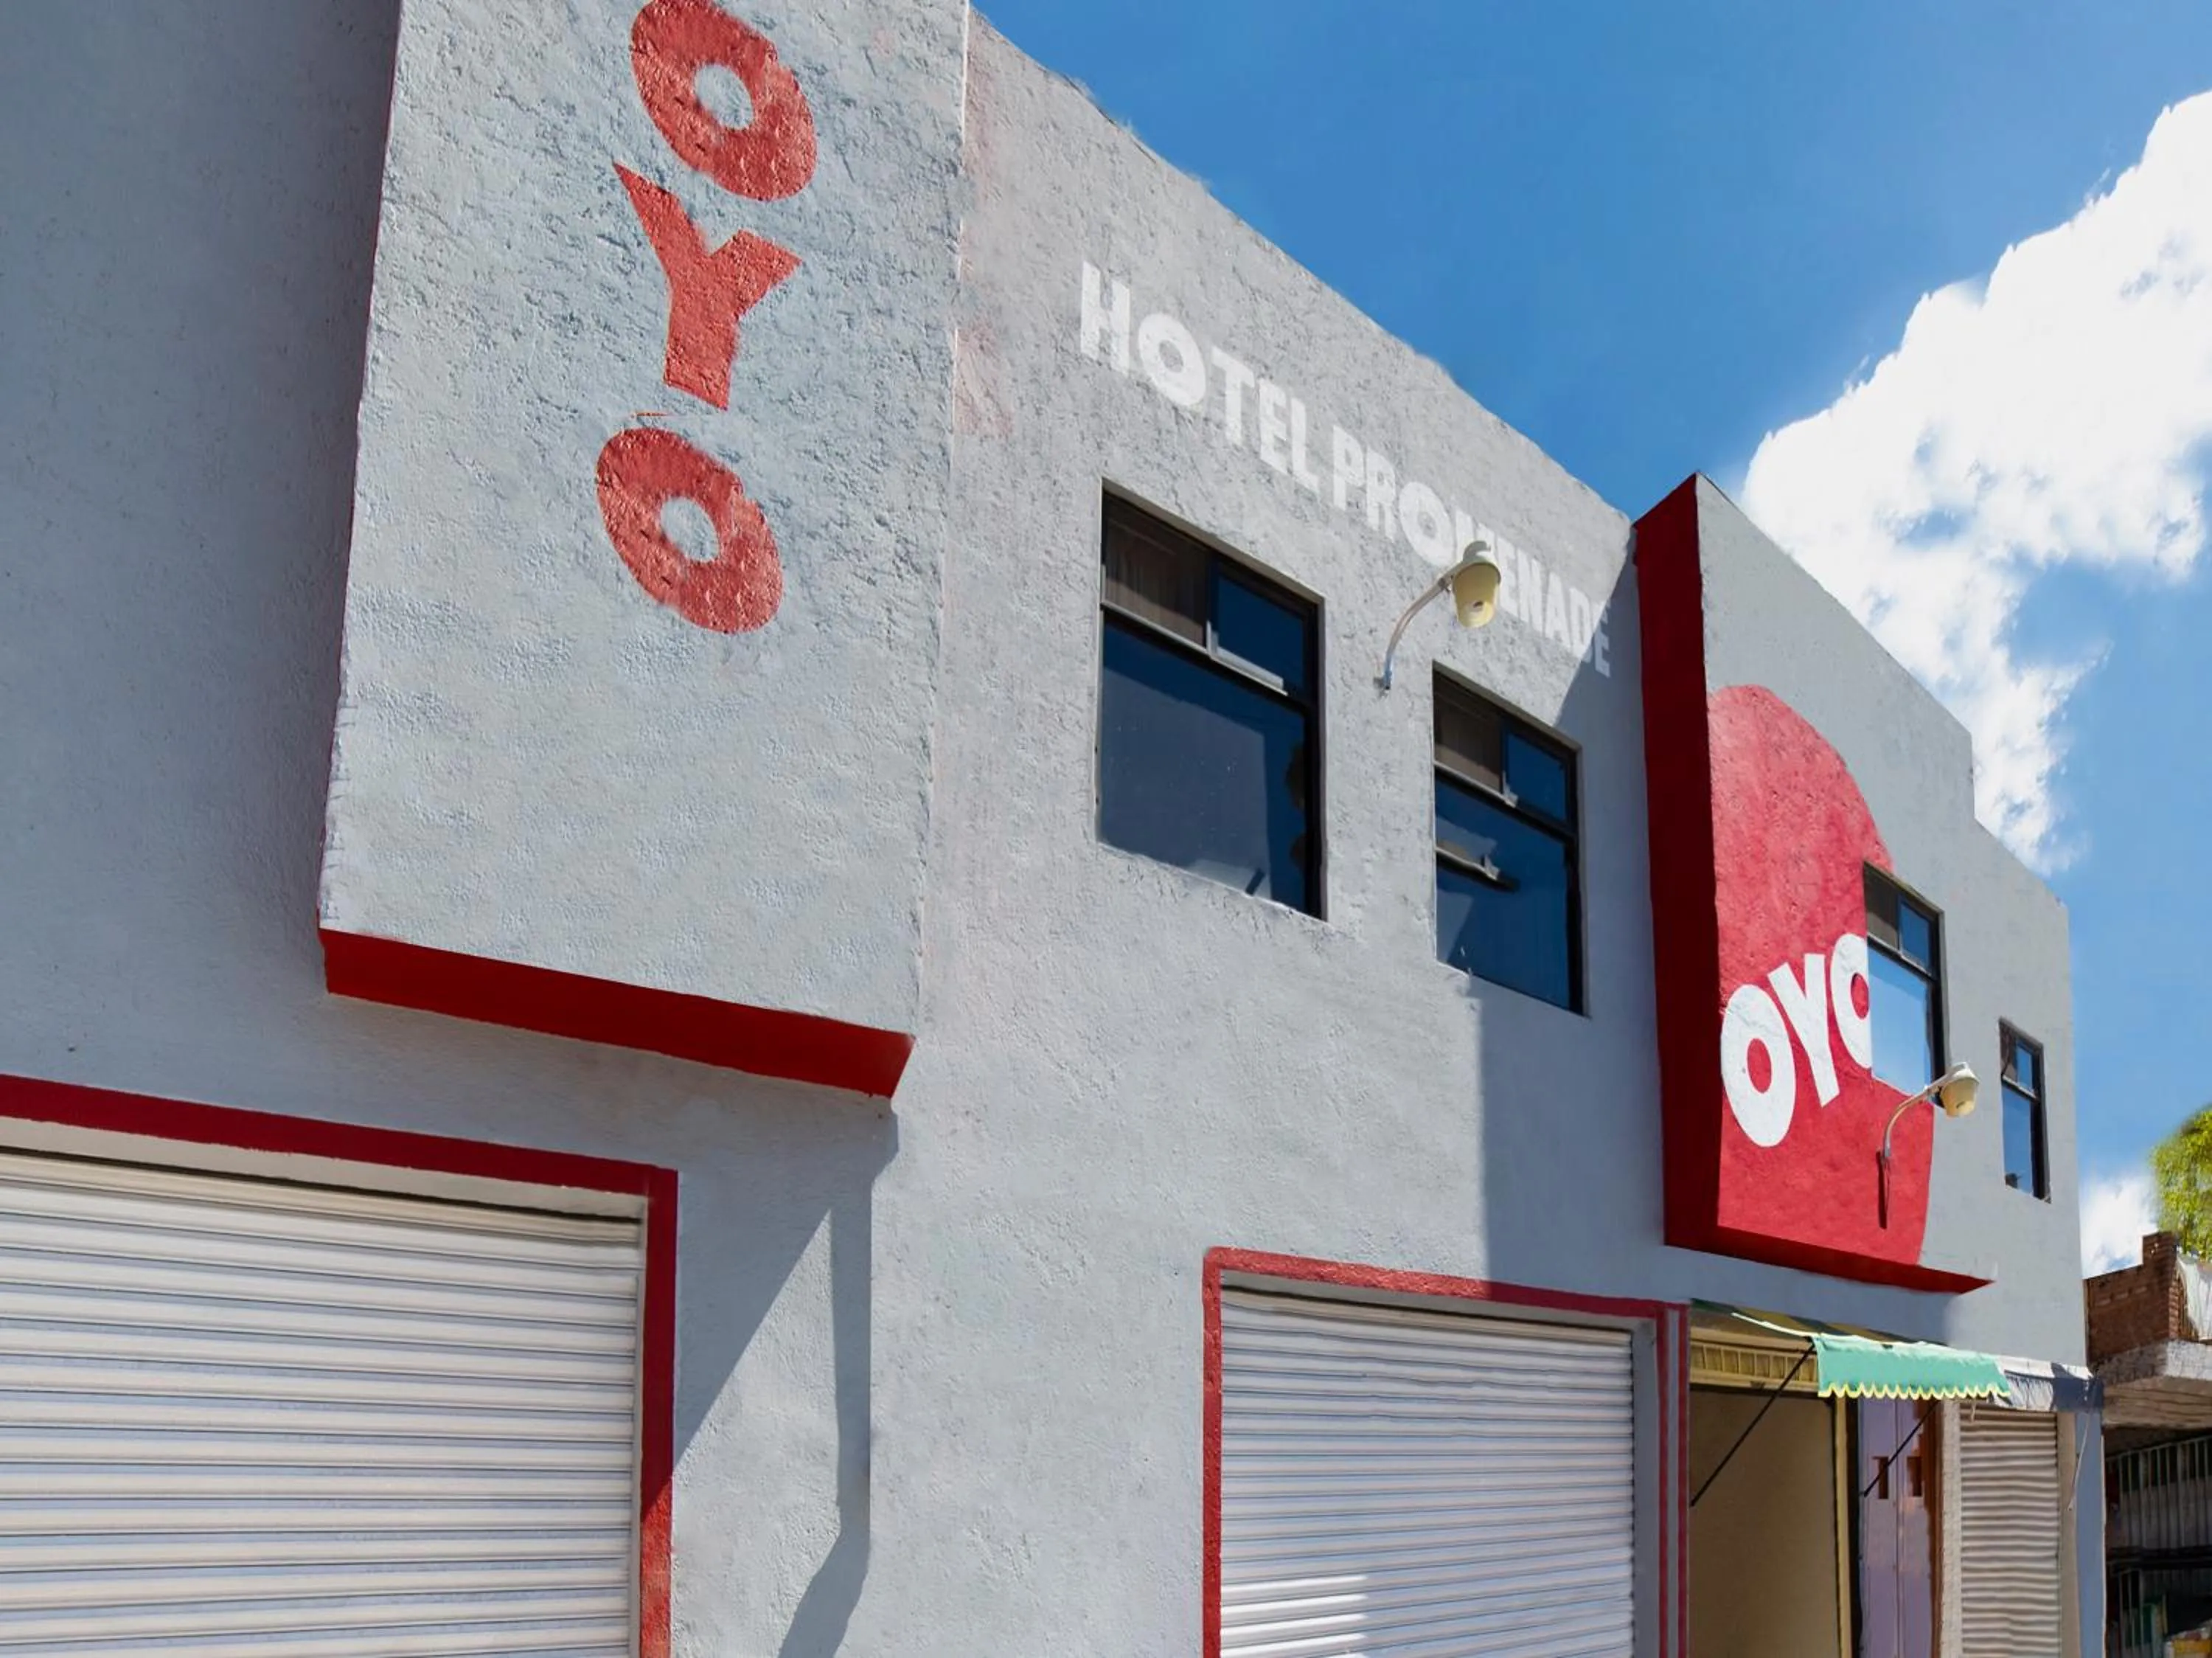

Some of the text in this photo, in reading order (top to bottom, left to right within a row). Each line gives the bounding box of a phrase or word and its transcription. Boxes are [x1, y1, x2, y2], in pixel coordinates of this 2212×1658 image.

[596, 0, 816, 634] OYO
[1079, 260, 1320, 495] HOTEL
[1720, 933, 1872, 1148] OYO
